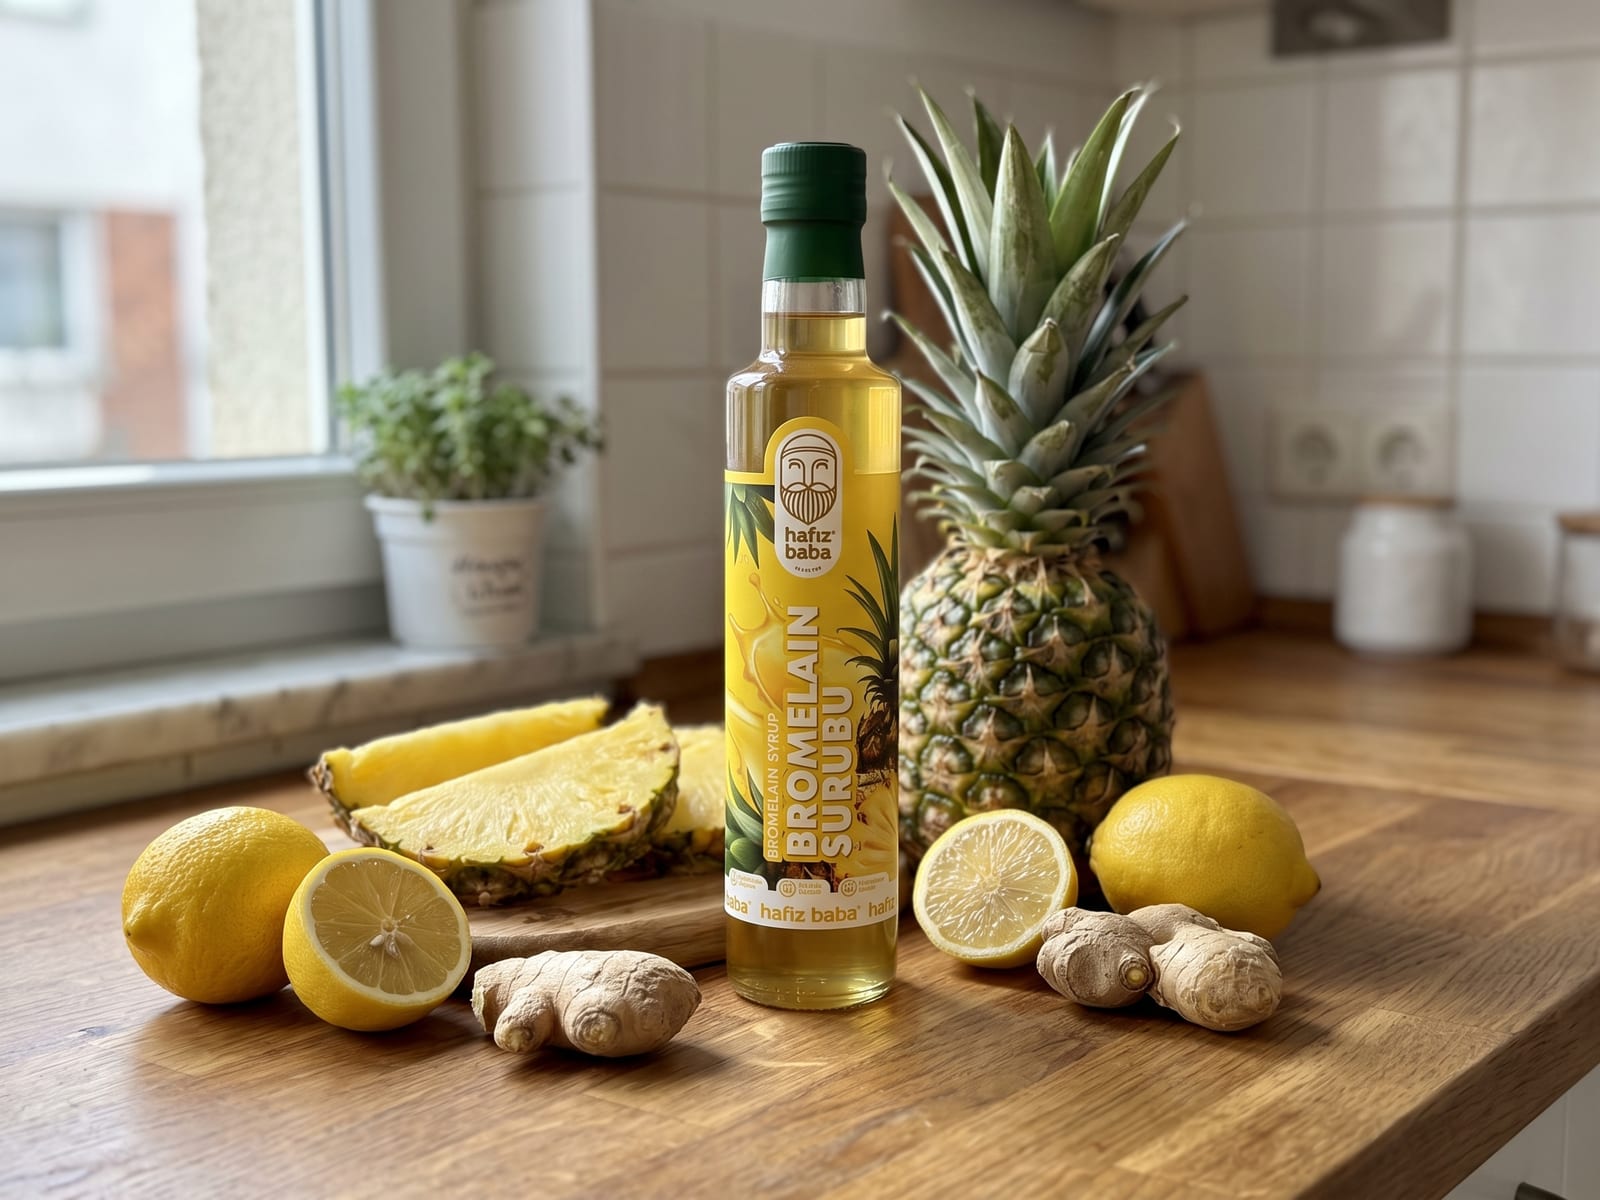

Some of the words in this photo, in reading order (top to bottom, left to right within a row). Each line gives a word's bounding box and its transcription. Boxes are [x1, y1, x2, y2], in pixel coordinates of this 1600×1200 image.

[785, 543, 832, 560] baba
[767, 713, 779, 762] SYRUP
[786, 606, 818, 856] BROMELAIN
[767, 768, 779, 858] BROMELAIN
[811, 906, 857, 923] baba
